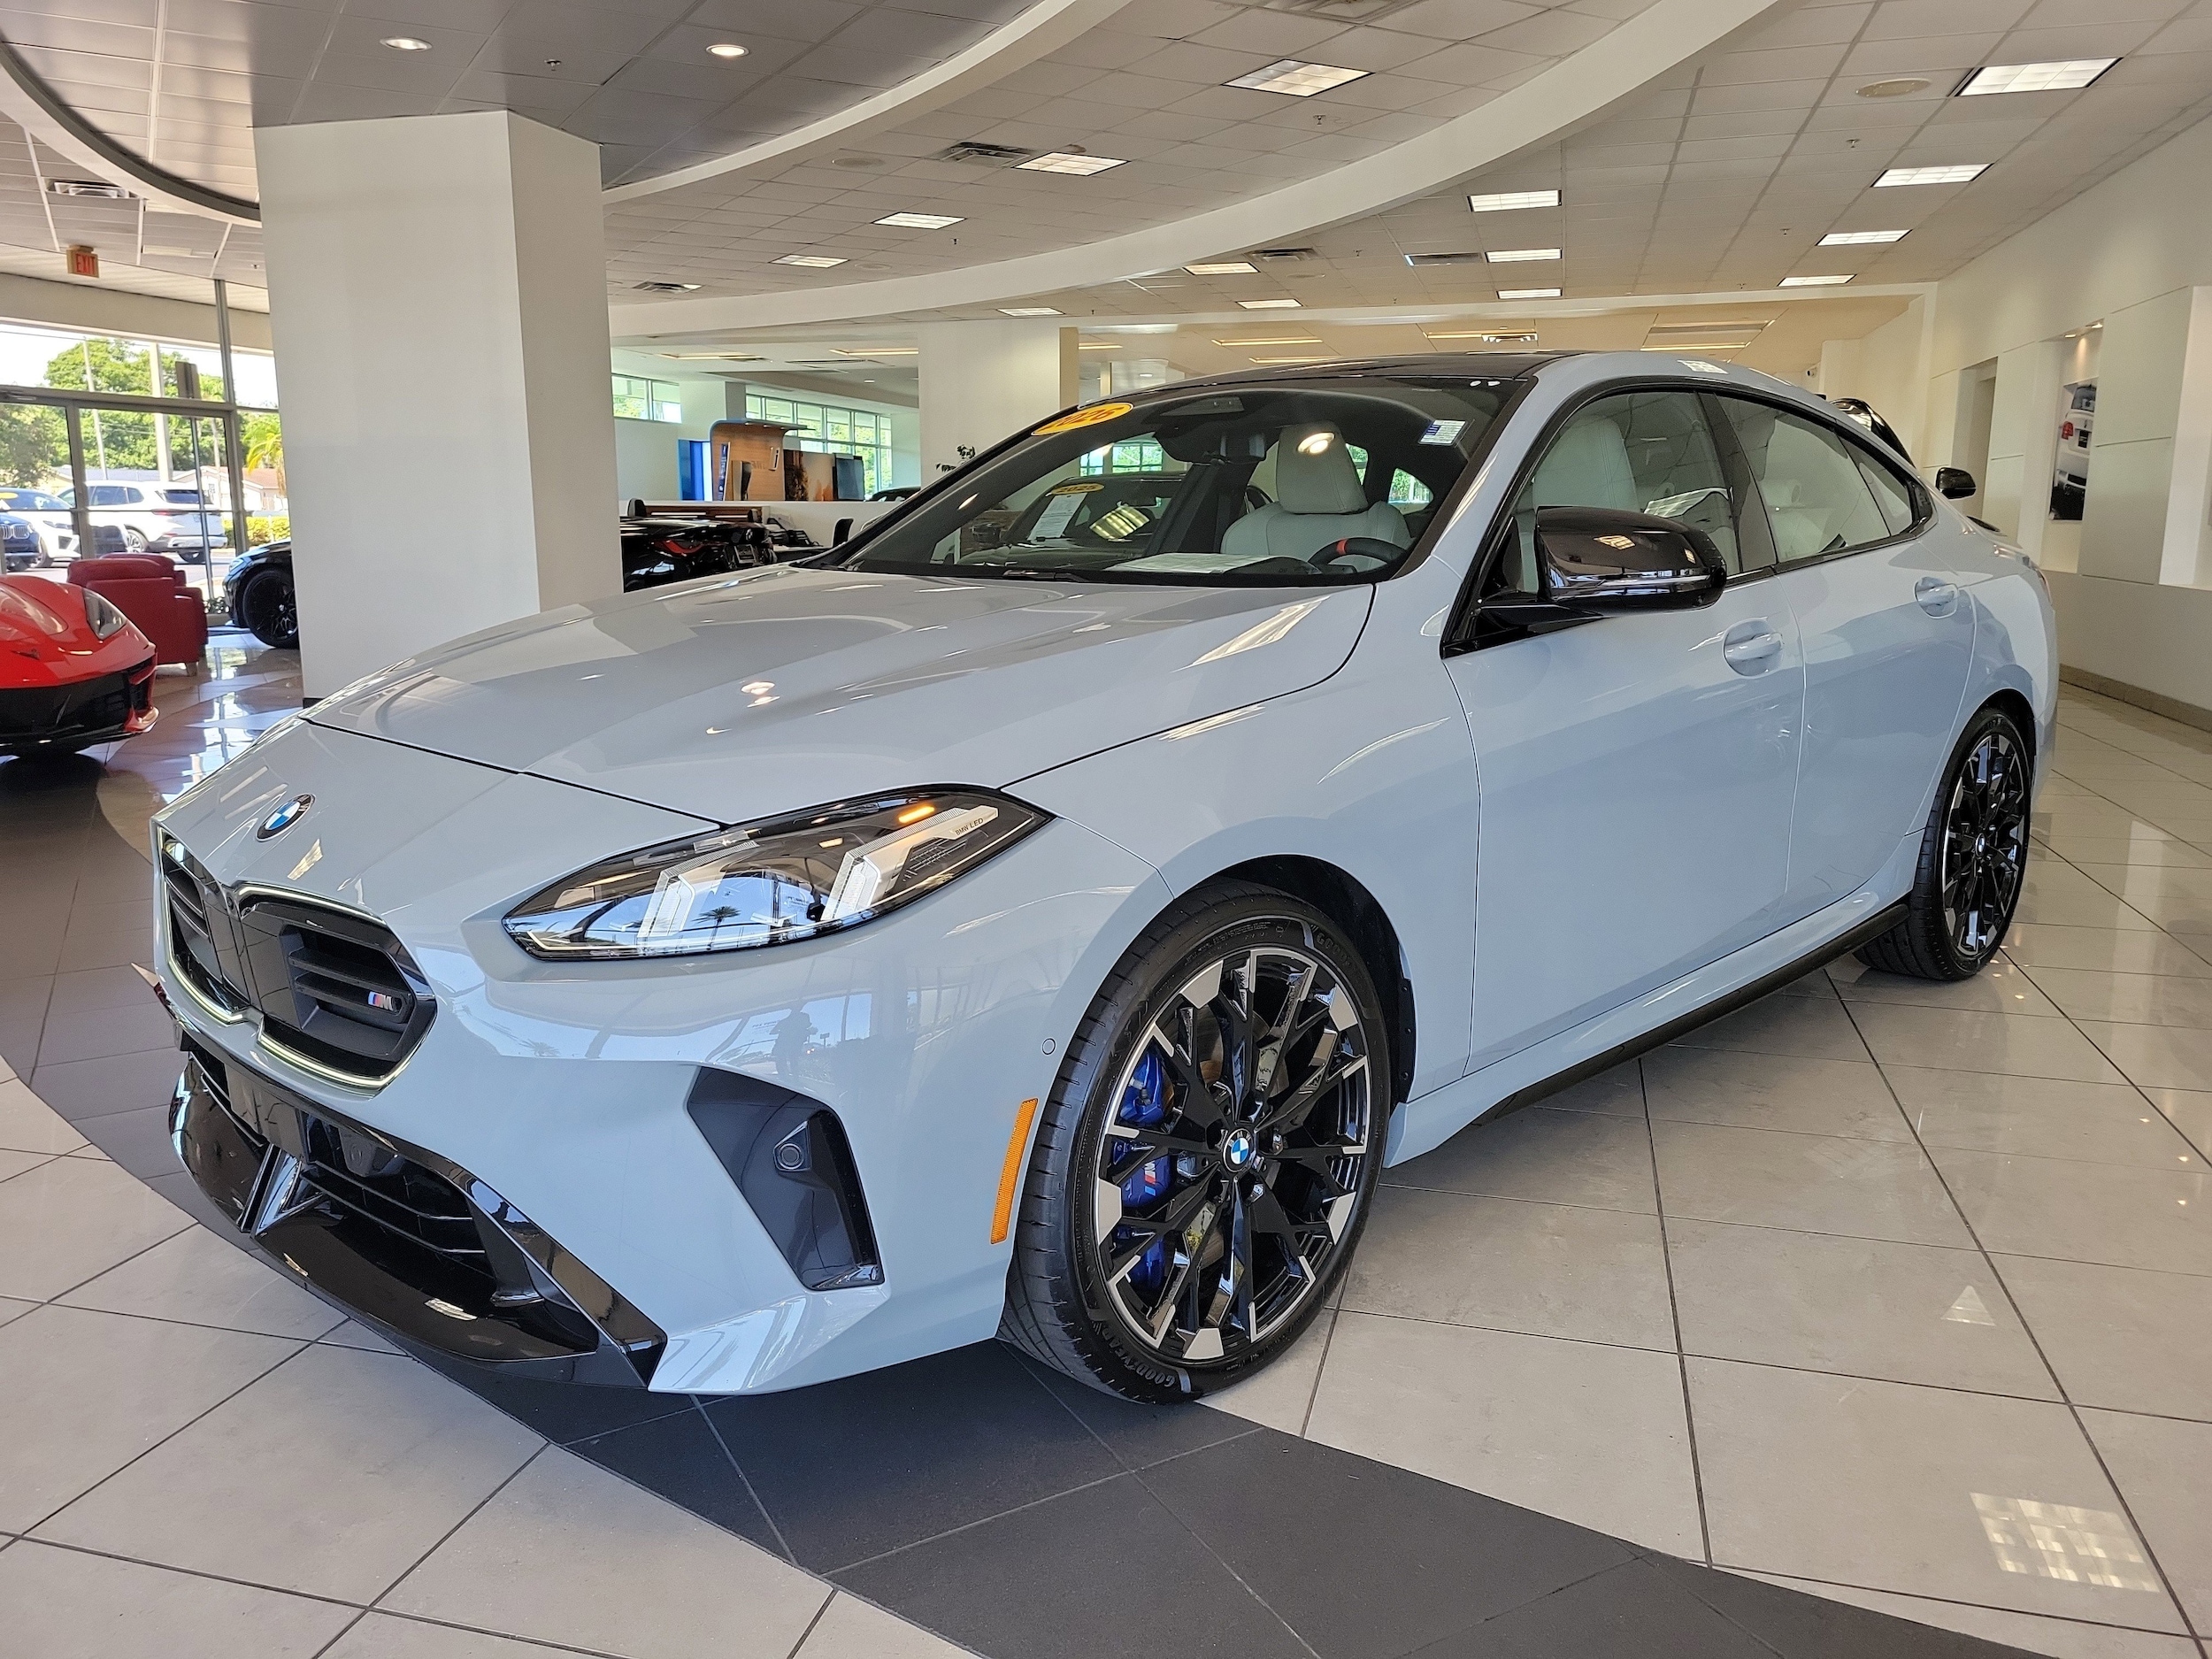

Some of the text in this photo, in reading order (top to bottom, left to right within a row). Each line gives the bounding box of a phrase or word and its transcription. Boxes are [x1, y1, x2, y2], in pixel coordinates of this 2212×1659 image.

[75, 253, 96, 275] EXIT
[955, 818, 984, 836] BMW LED
[1227, 1130, 1252, 1148] BMW
[1102, 1327, 1176, 1387] GOODYEAR
